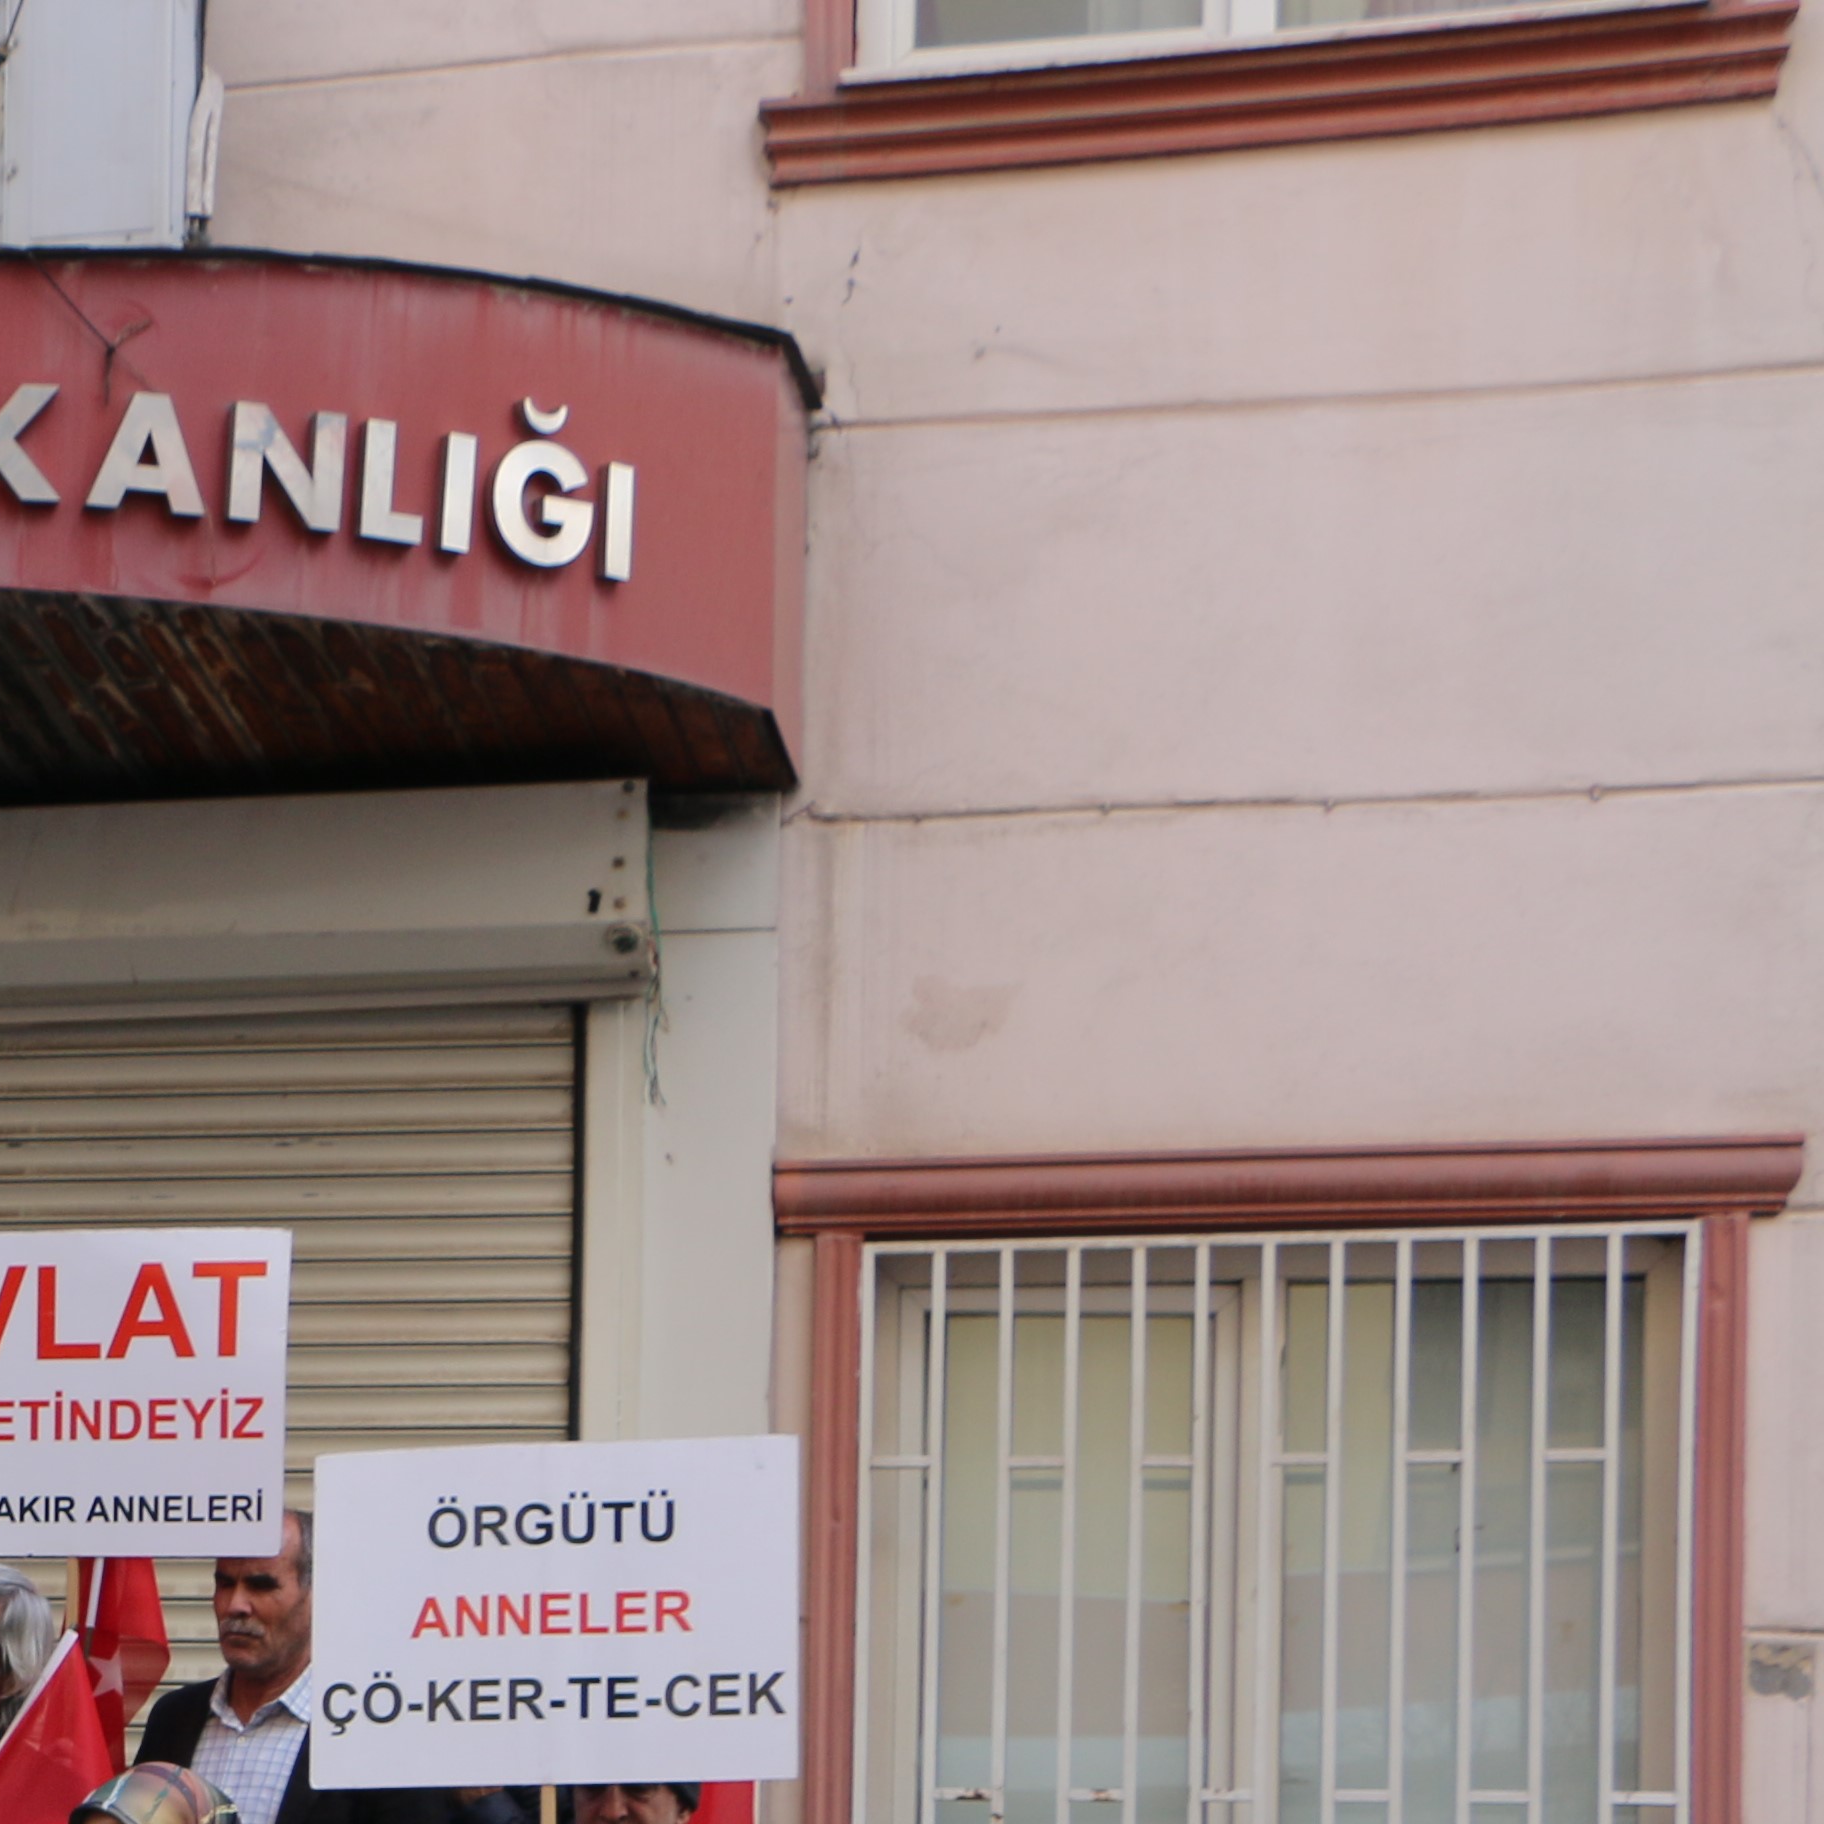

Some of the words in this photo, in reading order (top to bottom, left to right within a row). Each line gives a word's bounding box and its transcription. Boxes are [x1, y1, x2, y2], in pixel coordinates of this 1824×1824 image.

[86, 1488, 263, 1524] ANNELERİ
[427, 1489, 675, 1550] ÖRGÜTÜ
[410, 1589, 691, 1639] ANNELER
[321, 1670, 785, 1737] ÇÖ-KER-TE-CEK
